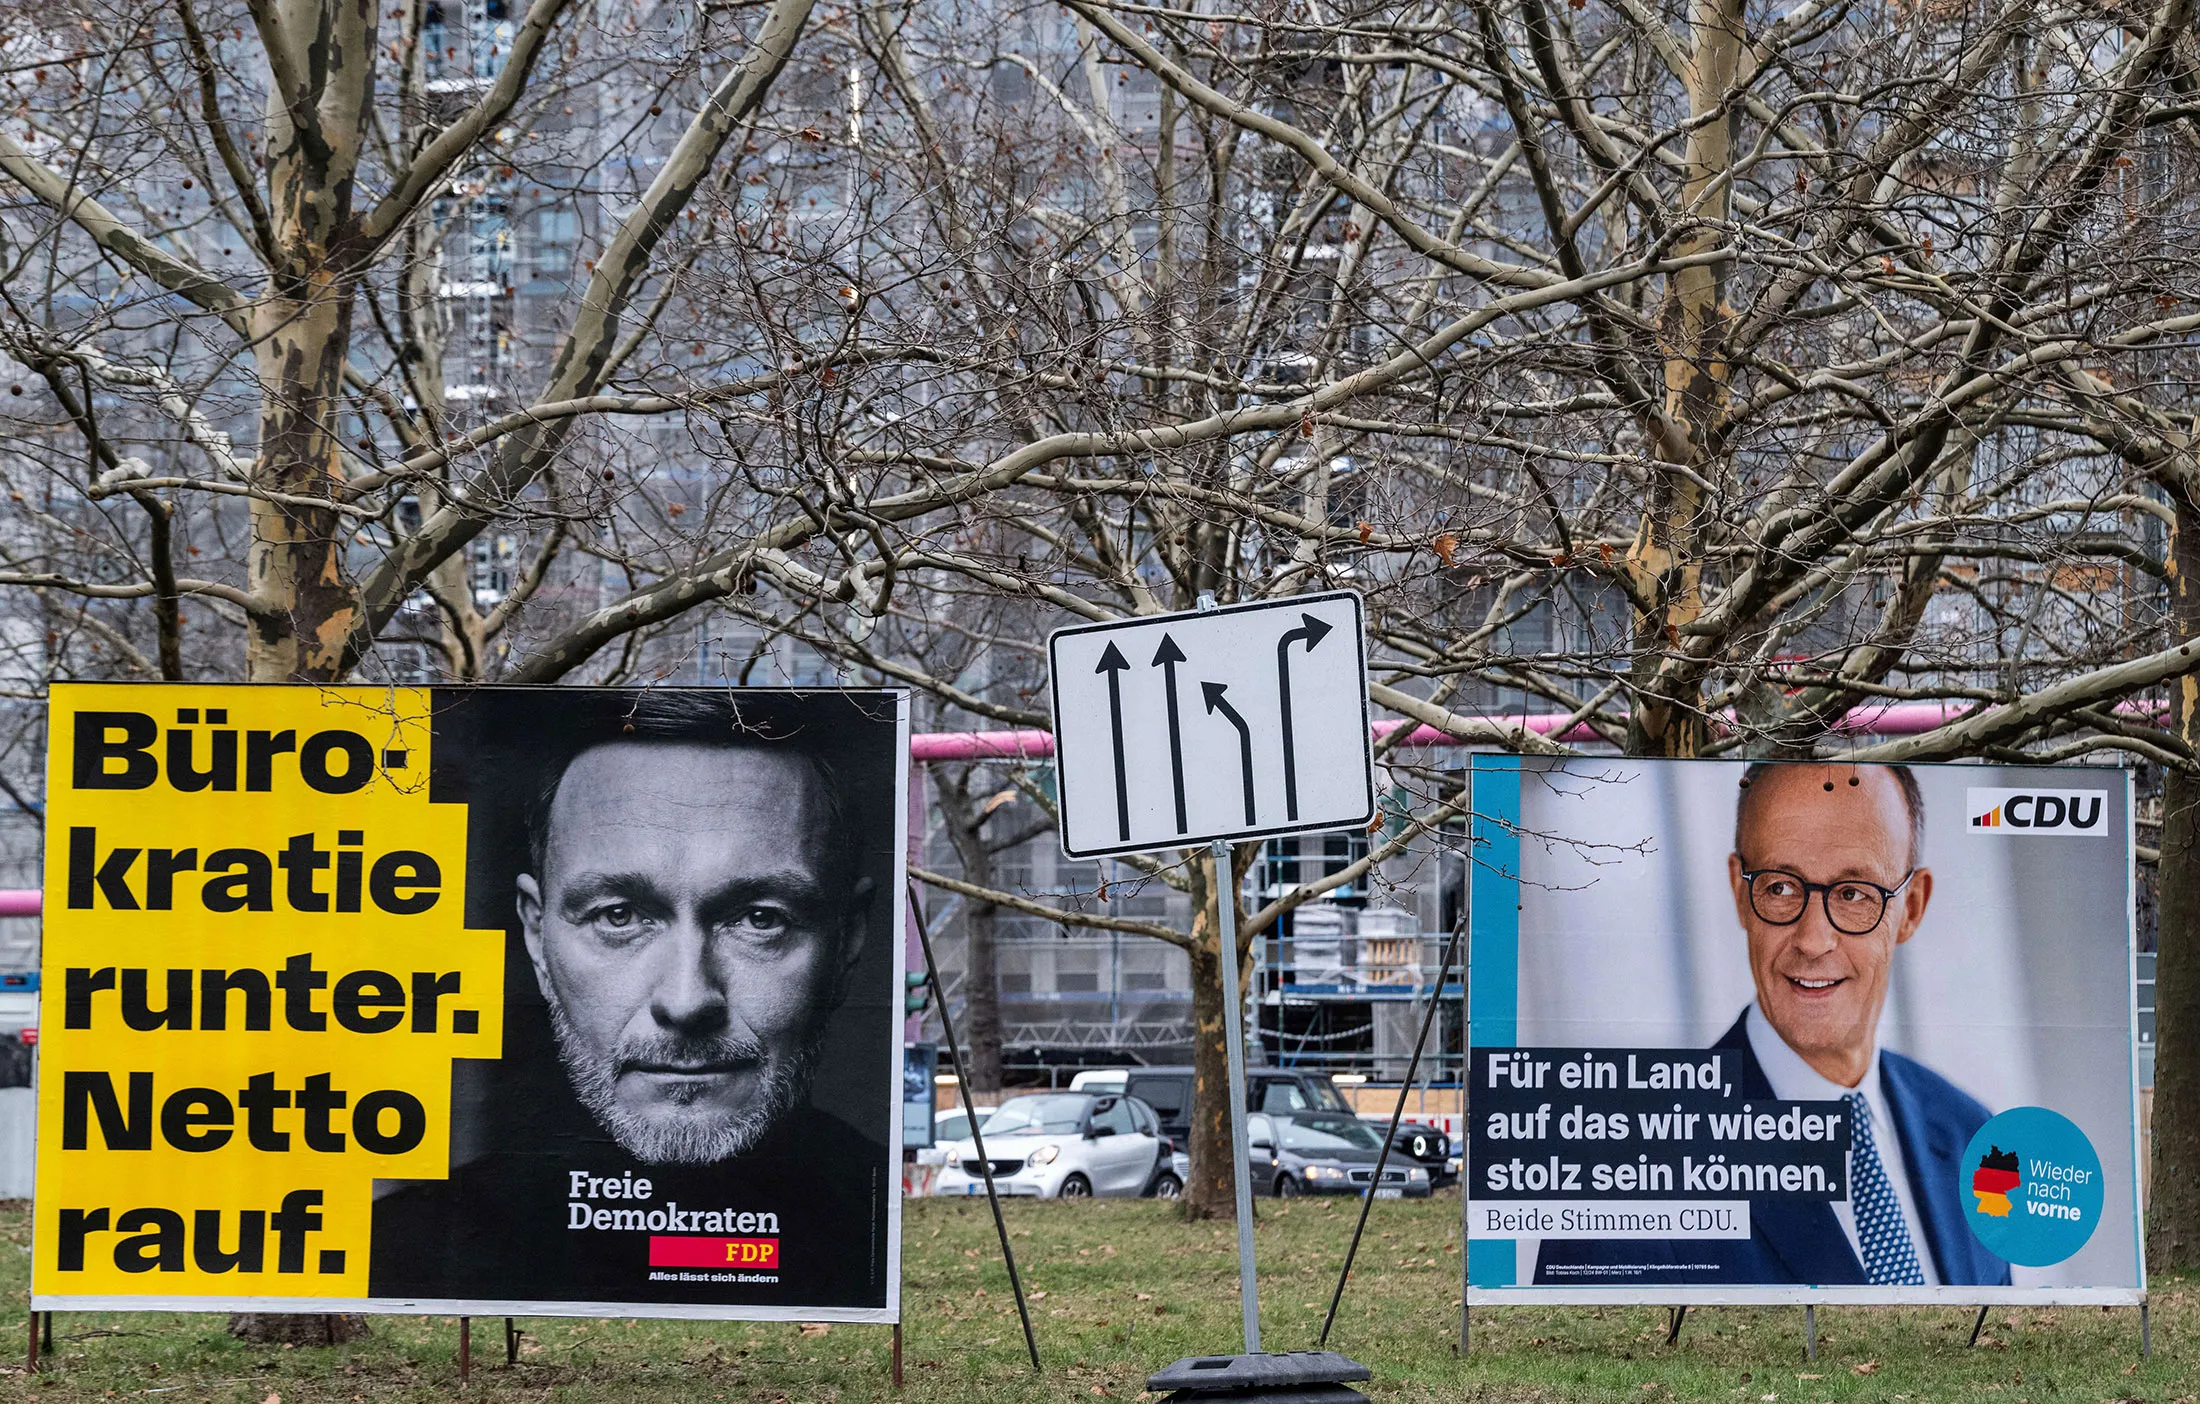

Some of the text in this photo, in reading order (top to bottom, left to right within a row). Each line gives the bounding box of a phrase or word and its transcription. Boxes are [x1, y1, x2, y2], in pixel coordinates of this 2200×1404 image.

[2004, 795, 2101, 828] CDU
[68, 827, 441, 915] kratie
[65, 953, 479, 1034] runter.
[1489, 1052, 1731, 1097] Für ein Land,
[63, 1072, 425, 1155] Netto
[1487, 1104, 1841, 1141] auf das wir wieder
[569, 1171, 652, 1199] Freie
[1487, 1154, 1836, 1191] stolz sein können.
[2030, 1160, 2092, 1184] Wieder
[2027, 1181, 2072, 1200] nach
[568, 1202, 779, 1233] Demokraten
[1487, 1208, 1736, 1231] Beide Stimmen CDU.
[2027, 1202, 2081, 1220] vorne
[58, 1190, 345, 1274] rauf.
[726, 1244, 773, 1261] FDP
[649, 1272, 778, 1282] Alles lässt sich ändern
